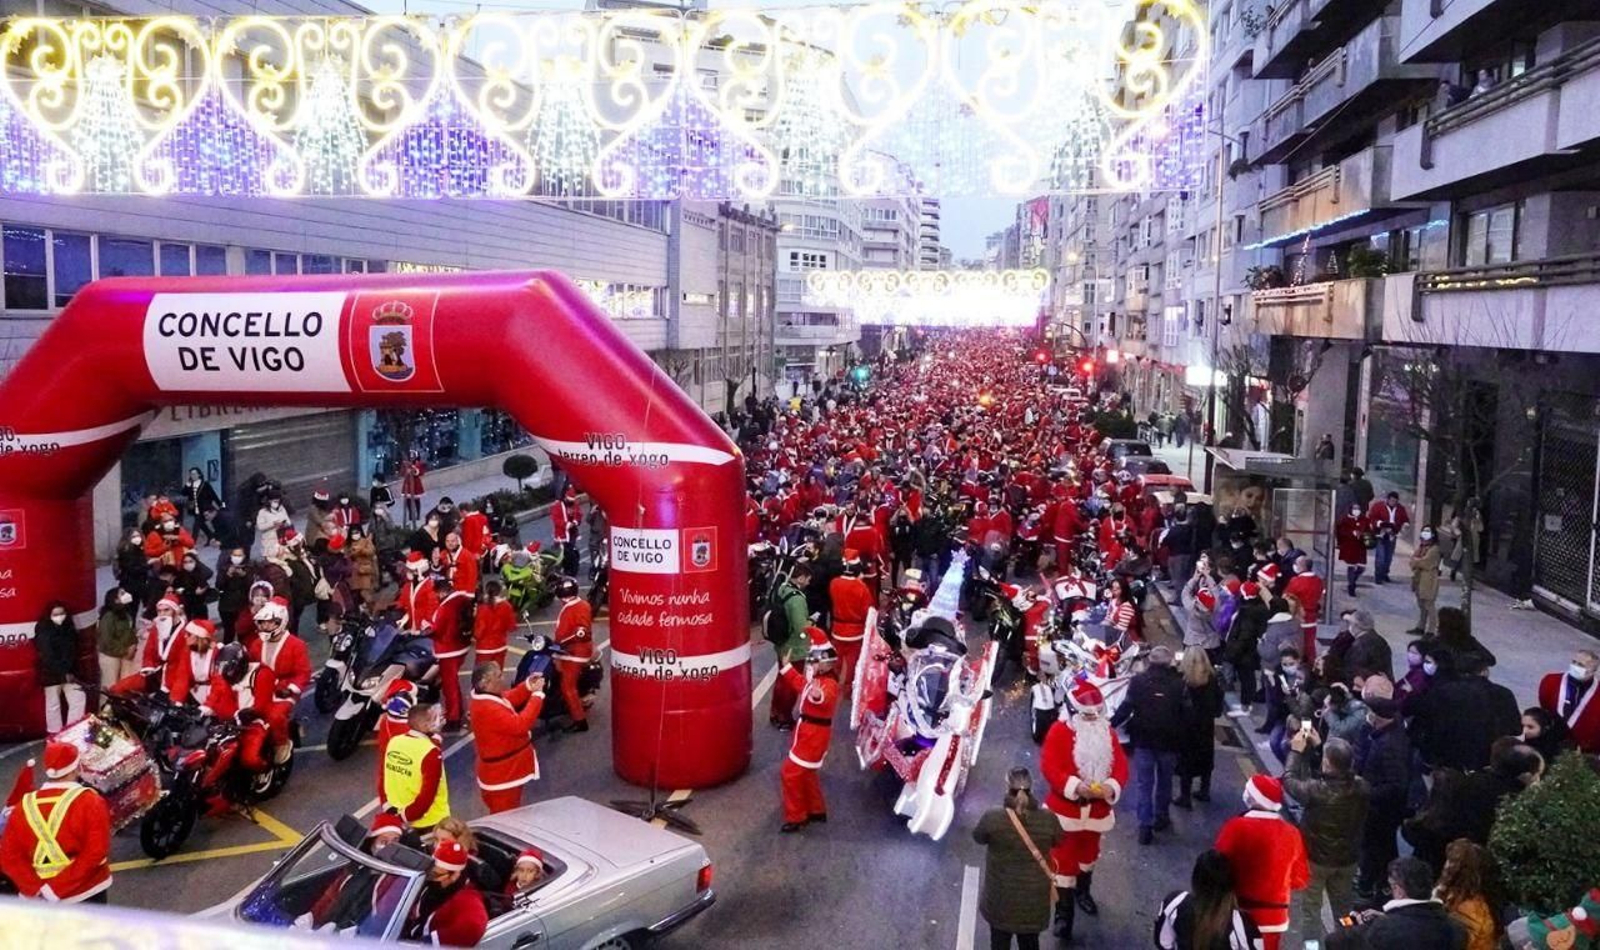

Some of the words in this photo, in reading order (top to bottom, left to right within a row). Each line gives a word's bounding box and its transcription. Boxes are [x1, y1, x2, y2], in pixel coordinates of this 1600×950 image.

[158, 311, 323, 338] CONCELLO
[177, 346, 221, 371] DE
[227, 346, 305, 372] VIGO
[20, 442, 61, 457] xogo
[584, 432, 631, 452] VIGO,
[604, 451, 623, 467] de
[629, 452, 670, 469] xogo
[613, 535, 672, 550] CONCELLO
[618, 550, 629, 562] DE
[633, 552, 664, 563] VIGO
[619, 588, 665, 606] Vivimos
[668, 588, 711, 605] nunha
[617, 609, 655, 627] cidade
[658, 610, 714, 627] fermosa
[638, 647, 683, 667] VIGO,
[655, 665, 674, 681] de
[681, 664, 719, 681] xogo
